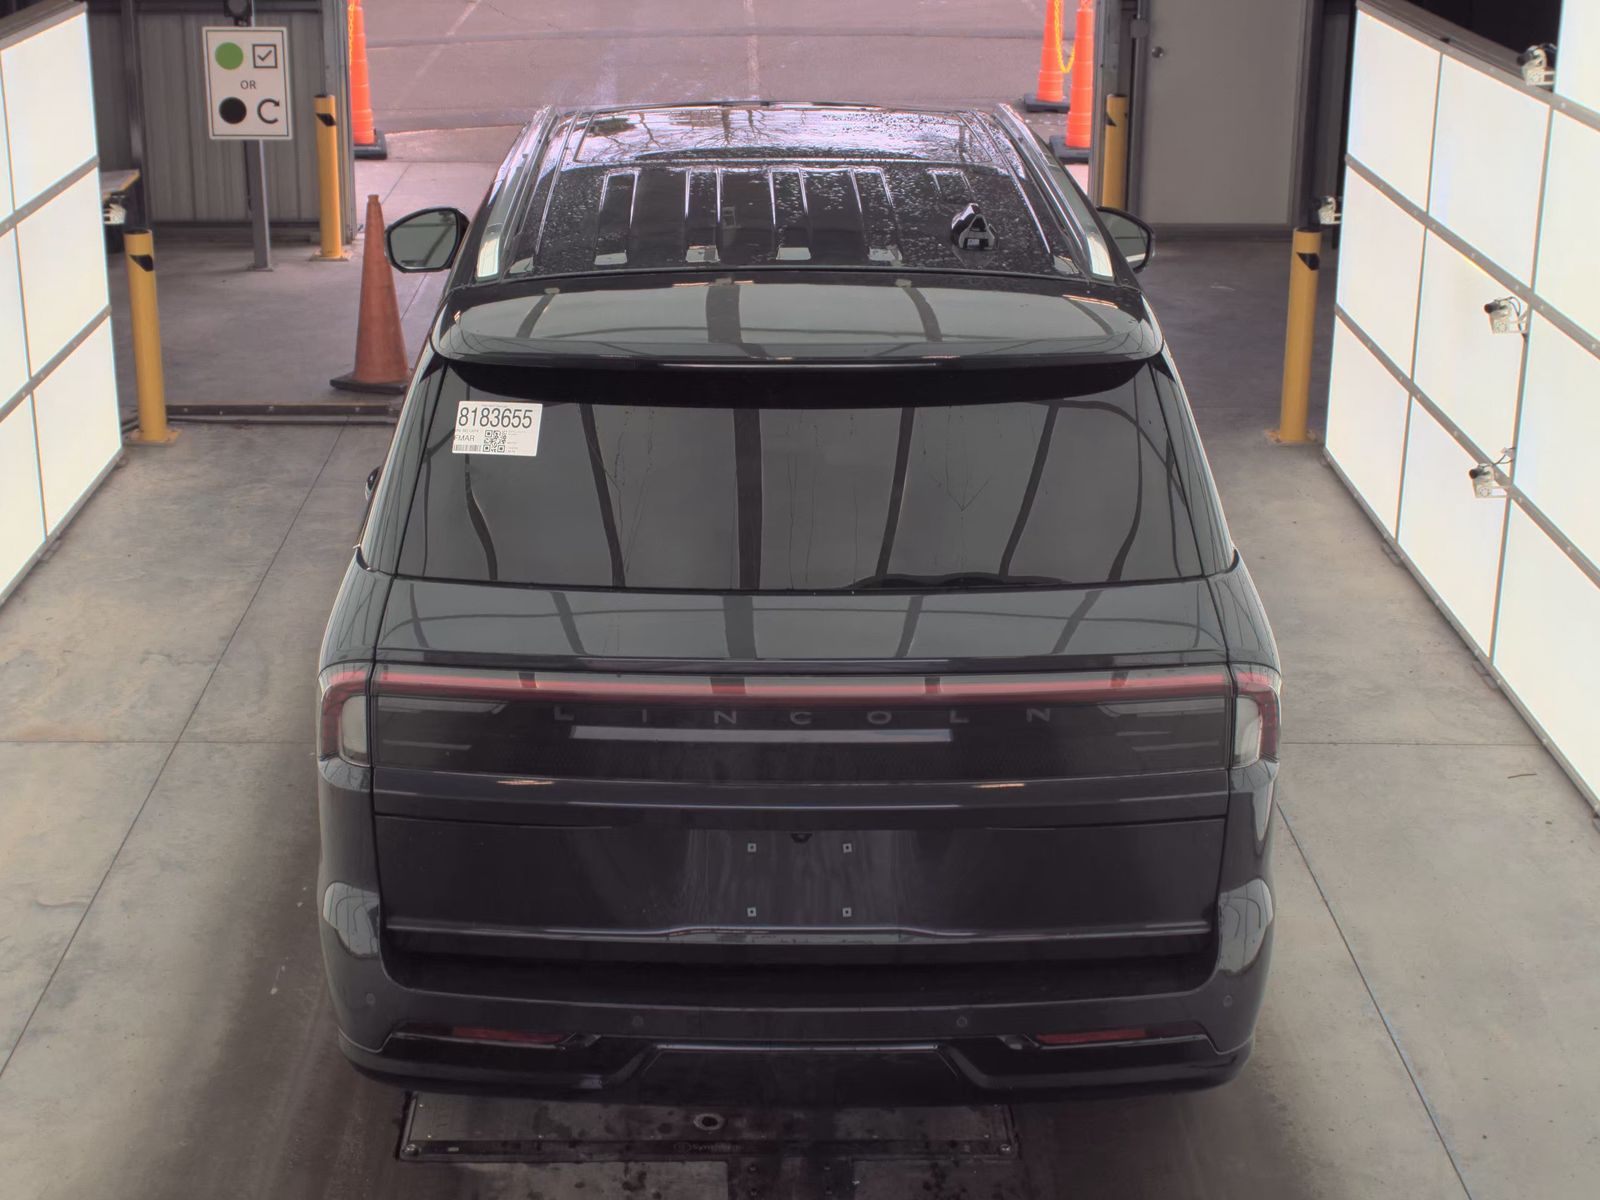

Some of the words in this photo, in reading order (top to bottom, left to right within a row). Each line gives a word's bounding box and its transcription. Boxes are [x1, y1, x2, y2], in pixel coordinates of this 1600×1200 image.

[240, 80, 257, 90] OR
[458, 407, 533, 429] 8183655
[553, 706, 1051, 725] LINCOLN
